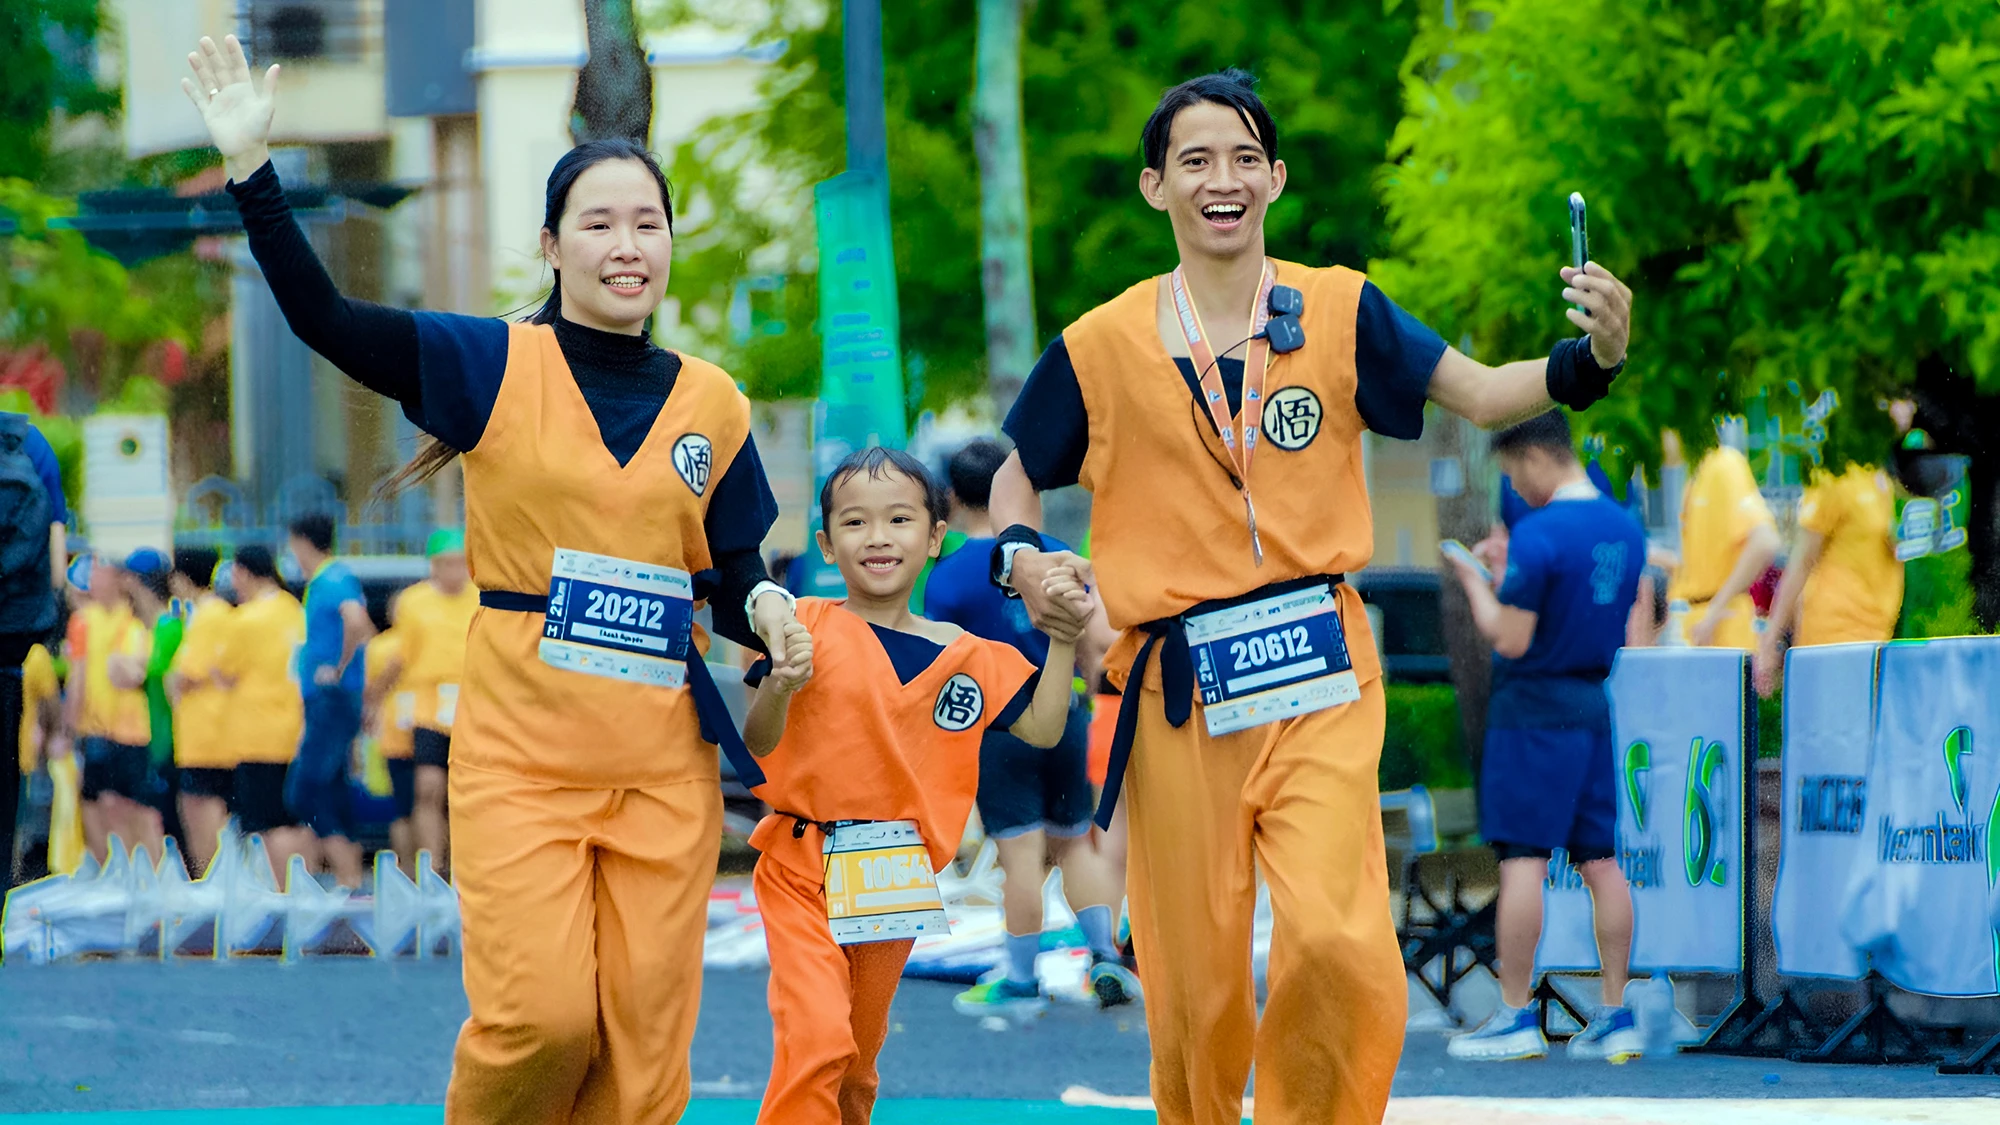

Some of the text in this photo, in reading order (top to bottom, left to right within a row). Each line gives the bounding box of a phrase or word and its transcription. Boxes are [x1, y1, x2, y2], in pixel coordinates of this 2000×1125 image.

[1272, 396, 1316, 443] 悟
[681, 442, 711, 486] 悟
[585, 589, 665, 631] 20212
[1230, 625, 1313, 671] 20612
[937, 680, 978, 725] 悟
